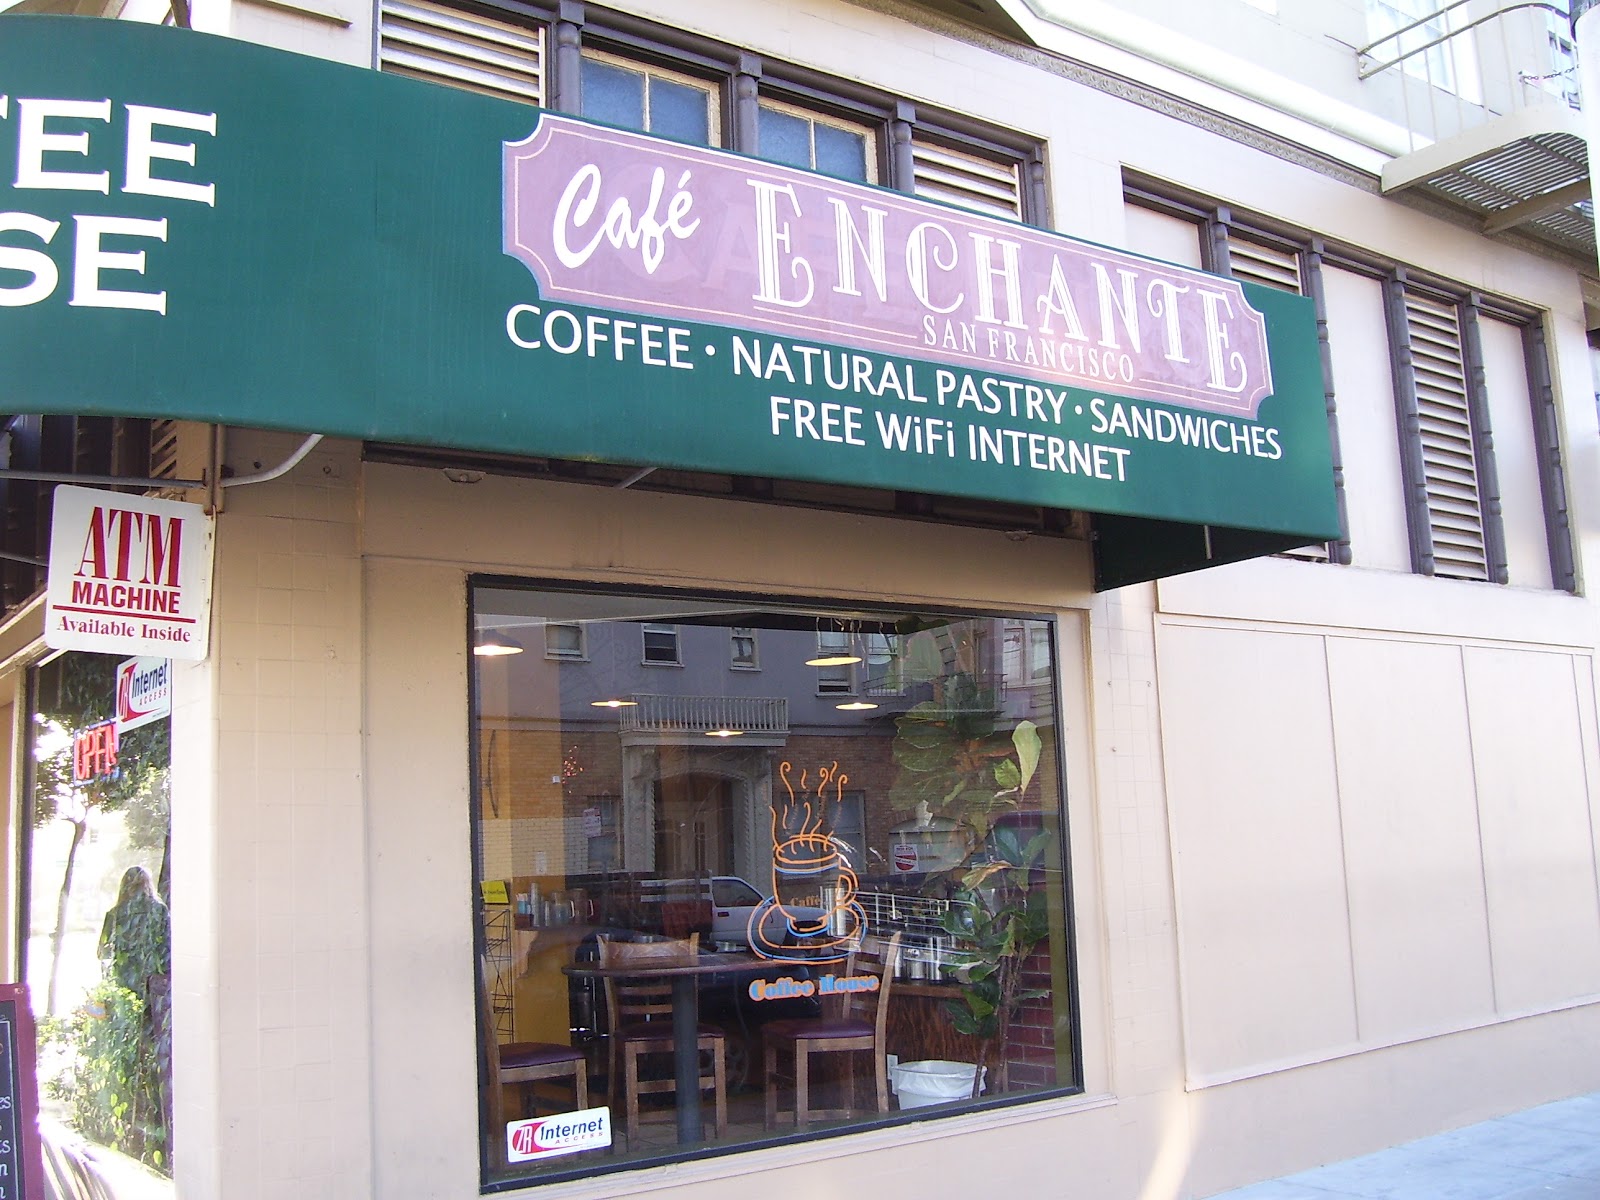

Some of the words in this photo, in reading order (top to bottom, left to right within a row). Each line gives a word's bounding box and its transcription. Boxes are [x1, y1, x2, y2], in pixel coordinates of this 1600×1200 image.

[0, 95, 217, 207] EE
[552, 163, 701, 275] Café
[746, 178, 1248, 394] ENCHANTE
[922, 314, 977, 354] SAN
[986, 326, 1135, 383] FRANCISCO
[505, 303, 695, 370] COFFEE
[732, 335, 928, 404] NATURAL
[935, 368, 1068, 425] PASTRY
[1089, 397, 1283, 460] SANDWICHES
[770, 395, 866, 446] FREE
[874, 410, 955, 458] WiFi
[967, 423, 1131, 482] INTERNET
[73, 506, 186, 588] ATM
[71, 580, 181, 614] MACHINE
[56, 615, 136, 637] Available
[140, 623, 191, 643] Inside
[131, 657, 168, 699] Internet
[139, 687, 168, 706] ACCESS
[748, 977, 816, 1002] Coffee
[818, 973, 880, 996] House
[540, 1117, 603, 1141] Internet
[555, 1131, 603, 1145] ACCESS
